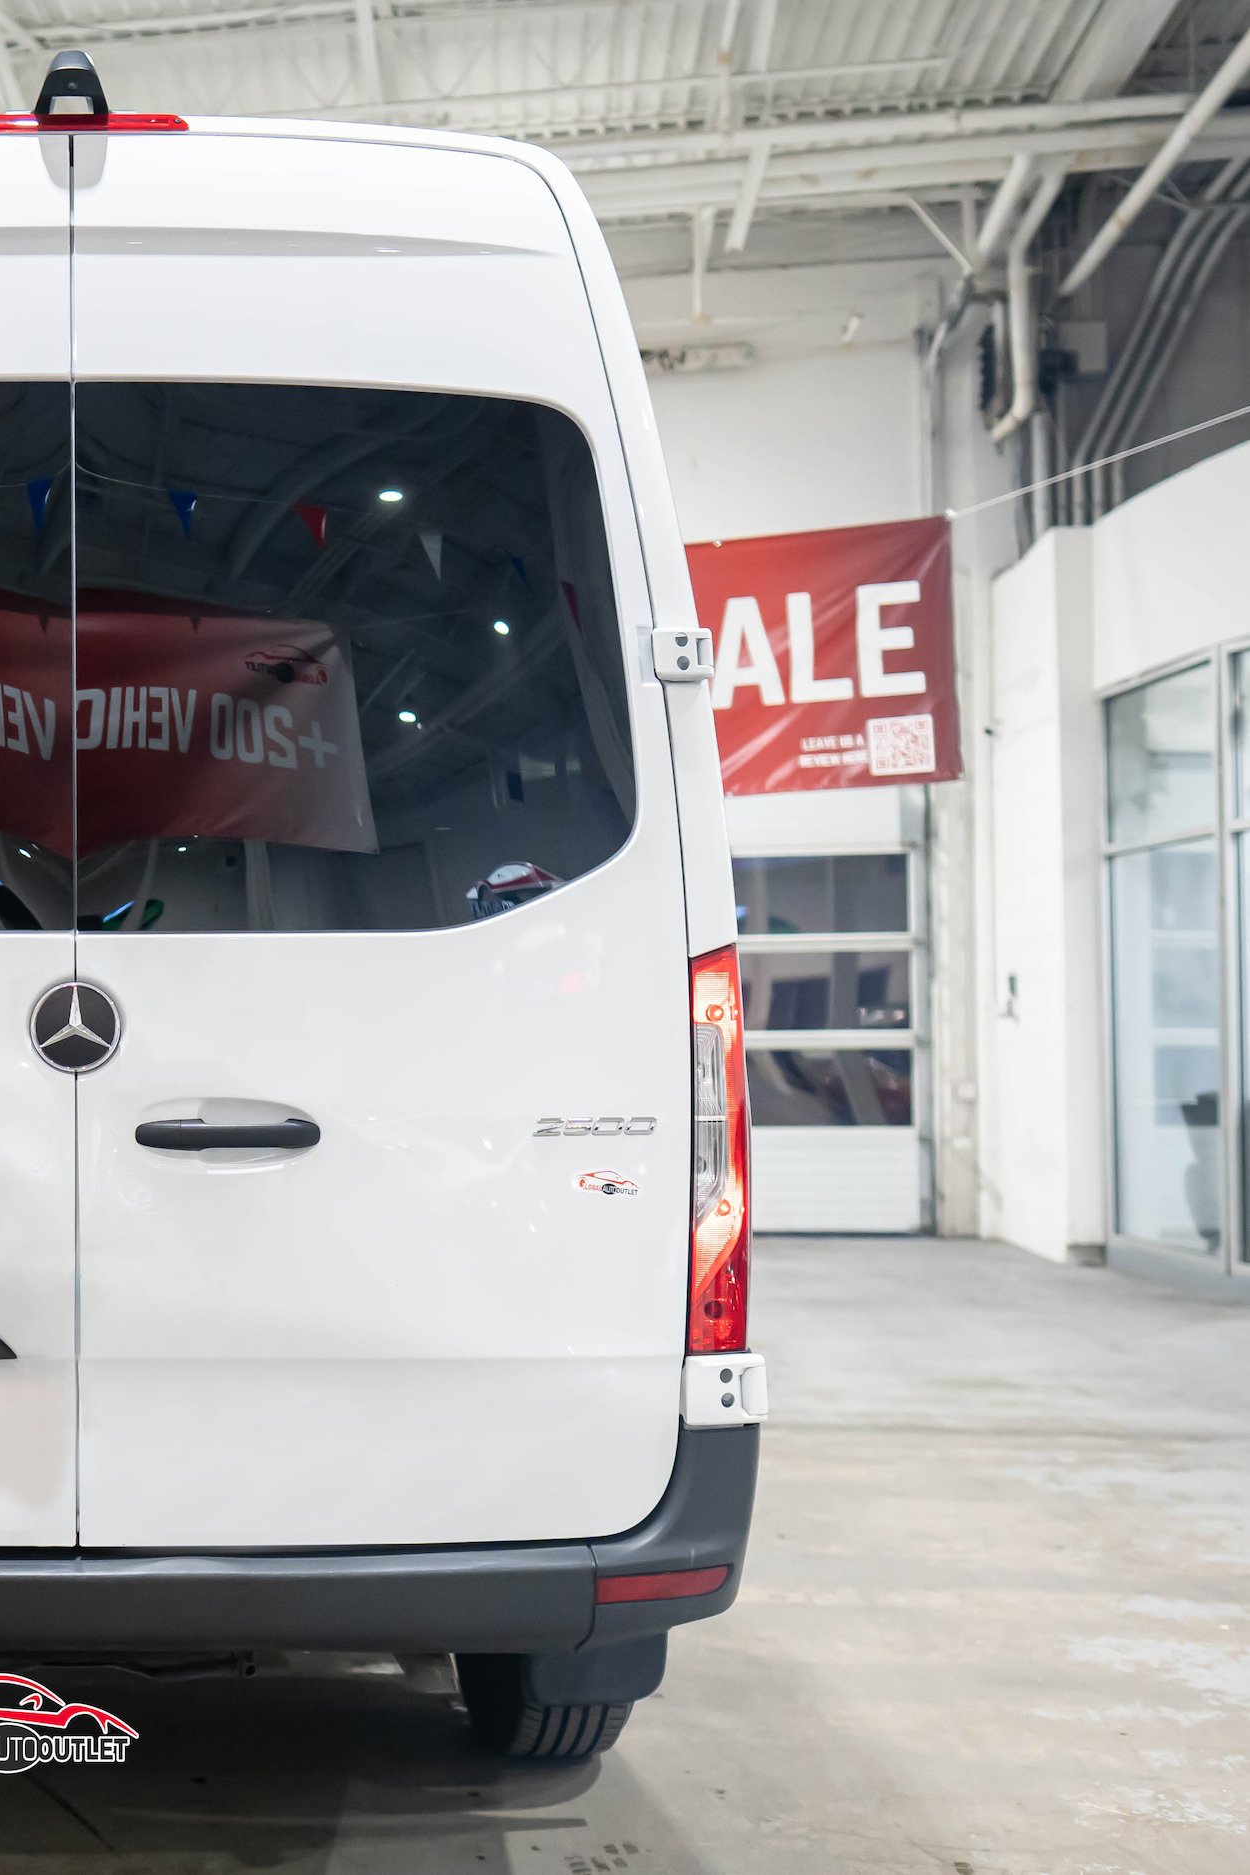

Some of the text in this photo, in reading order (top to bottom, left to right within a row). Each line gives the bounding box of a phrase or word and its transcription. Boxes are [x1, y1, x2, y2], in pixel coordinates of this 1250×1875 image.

[801, 735, 837, 751] LEAVE
[855, 734, 864, 746] A
[532, 1116, 658, 1137] 2500
[579, 1179, 603, 1191] GLOBAL
[616, 1187, 639, 1196] OUTLET
